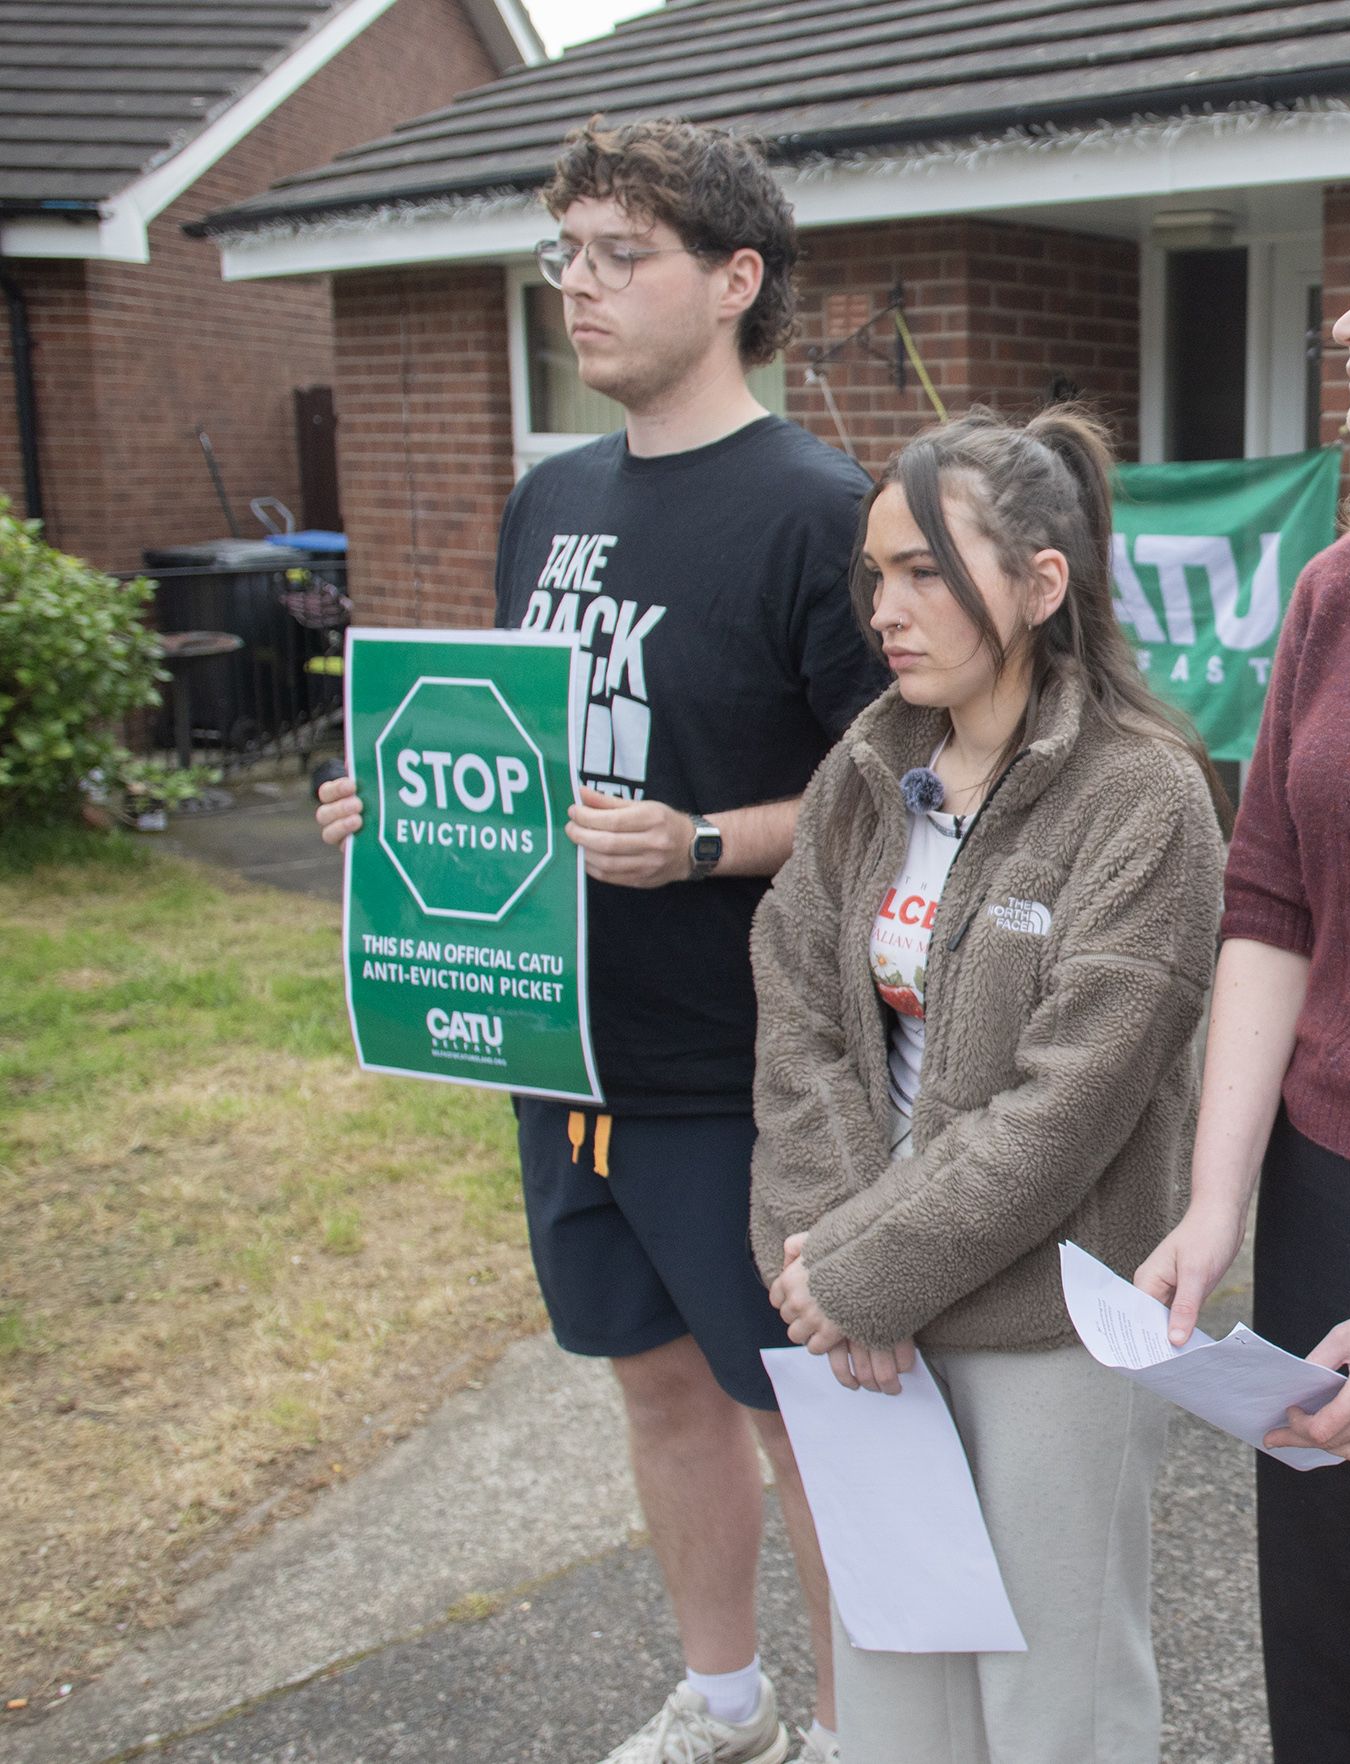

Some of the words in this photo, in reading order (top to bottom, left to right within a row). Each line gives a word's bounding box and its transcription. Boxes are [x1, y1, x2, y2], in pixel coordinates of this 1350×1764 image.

[537, 534, 618, 593] TAKE
[1109, 531, 1282, 651] ATU
[1135, 650, 1272, 685] FAST
[397, 748, 529, 814] STOP
[396, 818, 534, 853] EVICTIONS
[987, 903, 1030, 920] NORTH
[1008, 896, 1032, 911] THE
[995, 917, 1030, 933] FACE
[362, 934, 398, 957] THIS
[400, 938, 415, 958] IS
[416, 940, 441, 962] AN
[444, 943, 516, 971] OFFICIAL
[518, 952, 563, 976] CATU
[362, 960, 495, 995] ANTI-EVICTION
[500, 976, 564, 1003] PICKET
[426, 1007, 504, 1048] CATU
